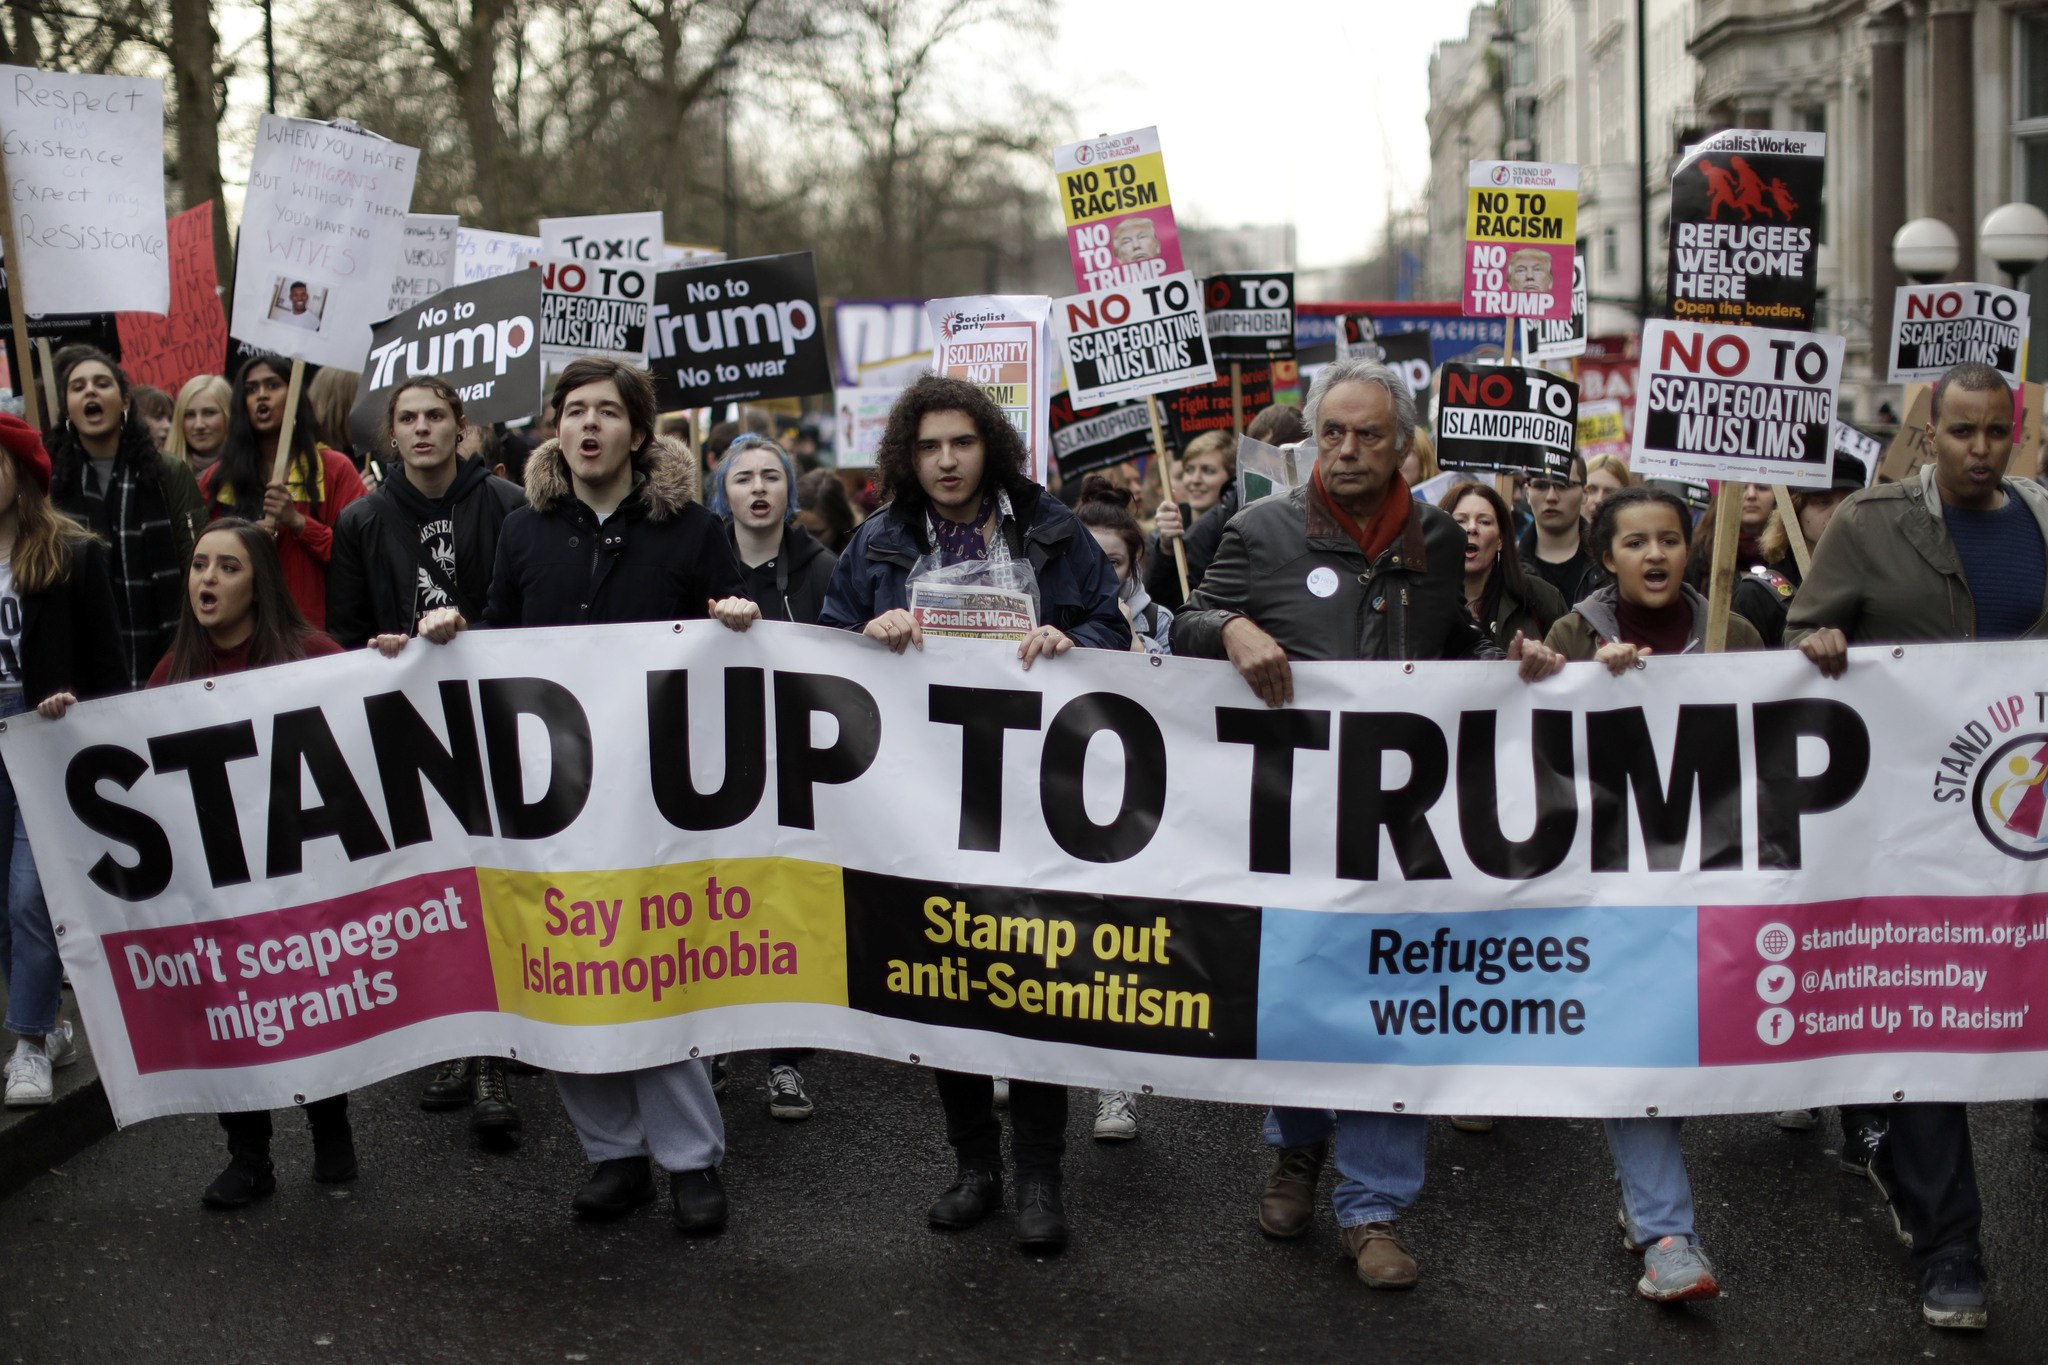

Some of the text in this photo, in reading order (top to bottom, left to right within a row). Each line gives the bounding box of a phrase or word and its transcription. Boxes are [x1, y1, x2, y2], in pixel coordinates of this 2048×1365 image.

[14, 74, 145, 116] Respect
[2, 129, 124, 167] Existence
[266, 122, 319, 150] WHEN
[325, 136, 354, 160] YOU
[363, 150, 406, 172] HATE
[1757, 137, 1807, 153] Worker
[290, 154, 377, 191] IMMIGRANTS
[1066, 163, 1136, 197] NO TO
[1512, 167, 1552, 176] STAND UP
[1512, 176, 1556, 186] TO RACISM
[12, 179, 93, 202] Expect
[252, 170, 406, 219] BUT WITHOUT THEM
[1071, 181, 1158, 219] RACISM
[1477, 192, 1546, 215] NO TO
[20, 213, 164, 261] Resistance
[314, 218, 346, 234] HAVE
[350, 227, 371, 239] NO
[1075, 223, 1110, 251] NO
[1475, 215, 1563, 239] RACISM
[1678, 222, 1812, 252] REFUGEES
[1079, 246, 1112, 273] TO
[1473, 245, 1507, 269] NO
[1676, 248, 1804, 277] WELCOME
[529, 261, 645, 300] NO TO
[686, 278, 750, 304] No to
[1083, 258, 1167, 293] TRUMP
[1472, 267, 1504, 291] TO
[1675, 273, 1746, 299] HERE
[1066, 280, 1189, 333] NO TO
[1205, 278, 1289, 308] O TO
[1471, 290, 1555, 316] TRUMP
[1674, 299, 1806, 319] Open the borders,
[1906, 289, 2017, 322] NO TO
[417, 301, 476, 331] No to
[541, 295, 647, 328] APEGOATING
[952, 321, 986, 335] Party
[955, 311, 1006, 325] Socialist
[1208, 311, 1288, 332] MOPHOBIA
[541, 318, 629, 351] MUSLIMS
[648, 299, 817, 360] Trump
[1068, 312, 1201, 363] SCAPEGOATING
[1900, 319, 2019, 350] SCAPEGOATING
[369, 315, 535, 392] Trump
[949, 342, 1029, 365] SOLIDARITY
[1095, 340, 1192, 385] MUSLIMS
[1659, 329, 1829, 385] NO TO
[1917, 340, 2000, 368] MUSLIMS
[676, 358, 787, 388] No to war
[966, 363, 1004, 384] NOT
[1212, 393, 1252, 410] racm
[1448, 372, 1512, 407] NO
[1526, 377, 1572, 418] TO
[1650, 377, 1831, 425] SCAPEGOATING
[1058, 406, 1164, 453] SLAMOPHOB
[1180, 411, 1256, 433] Islamoph
[1443, 409, 1570, 449] ISLAMOPHOBIA
[1676, 413, 1807, 460] MUSLIMS
[420, 519, 453, 543] ESTE
[922, 609, 1031, 630] Socialist Worker
[1933, 720, 1993, 803] STAND
[1987, 694, 2025, 734] UP
[65, 666, 1871, 902] STAND UP TO TRUMP
[543, 876, 751, 948] Say no to
[123, 886, 468, 991] Don't scapegoat
[922, 895, 1171, 969] Stamp out
[521, 928, 798, 1003] Islamophobia
[1368, 927, 1591, 985] Refugees
[886, 956, 1211, 1031] anti-Semitism
[1801, 964, 1988, 993] @AntiRacismDay
[206, 967, 398, 1047] migrants
[1369, 985, 1587, 1037] welcome
[1871, 1005, 1901, 1033] Up
[1909, 1005, 1934, 1029] To
